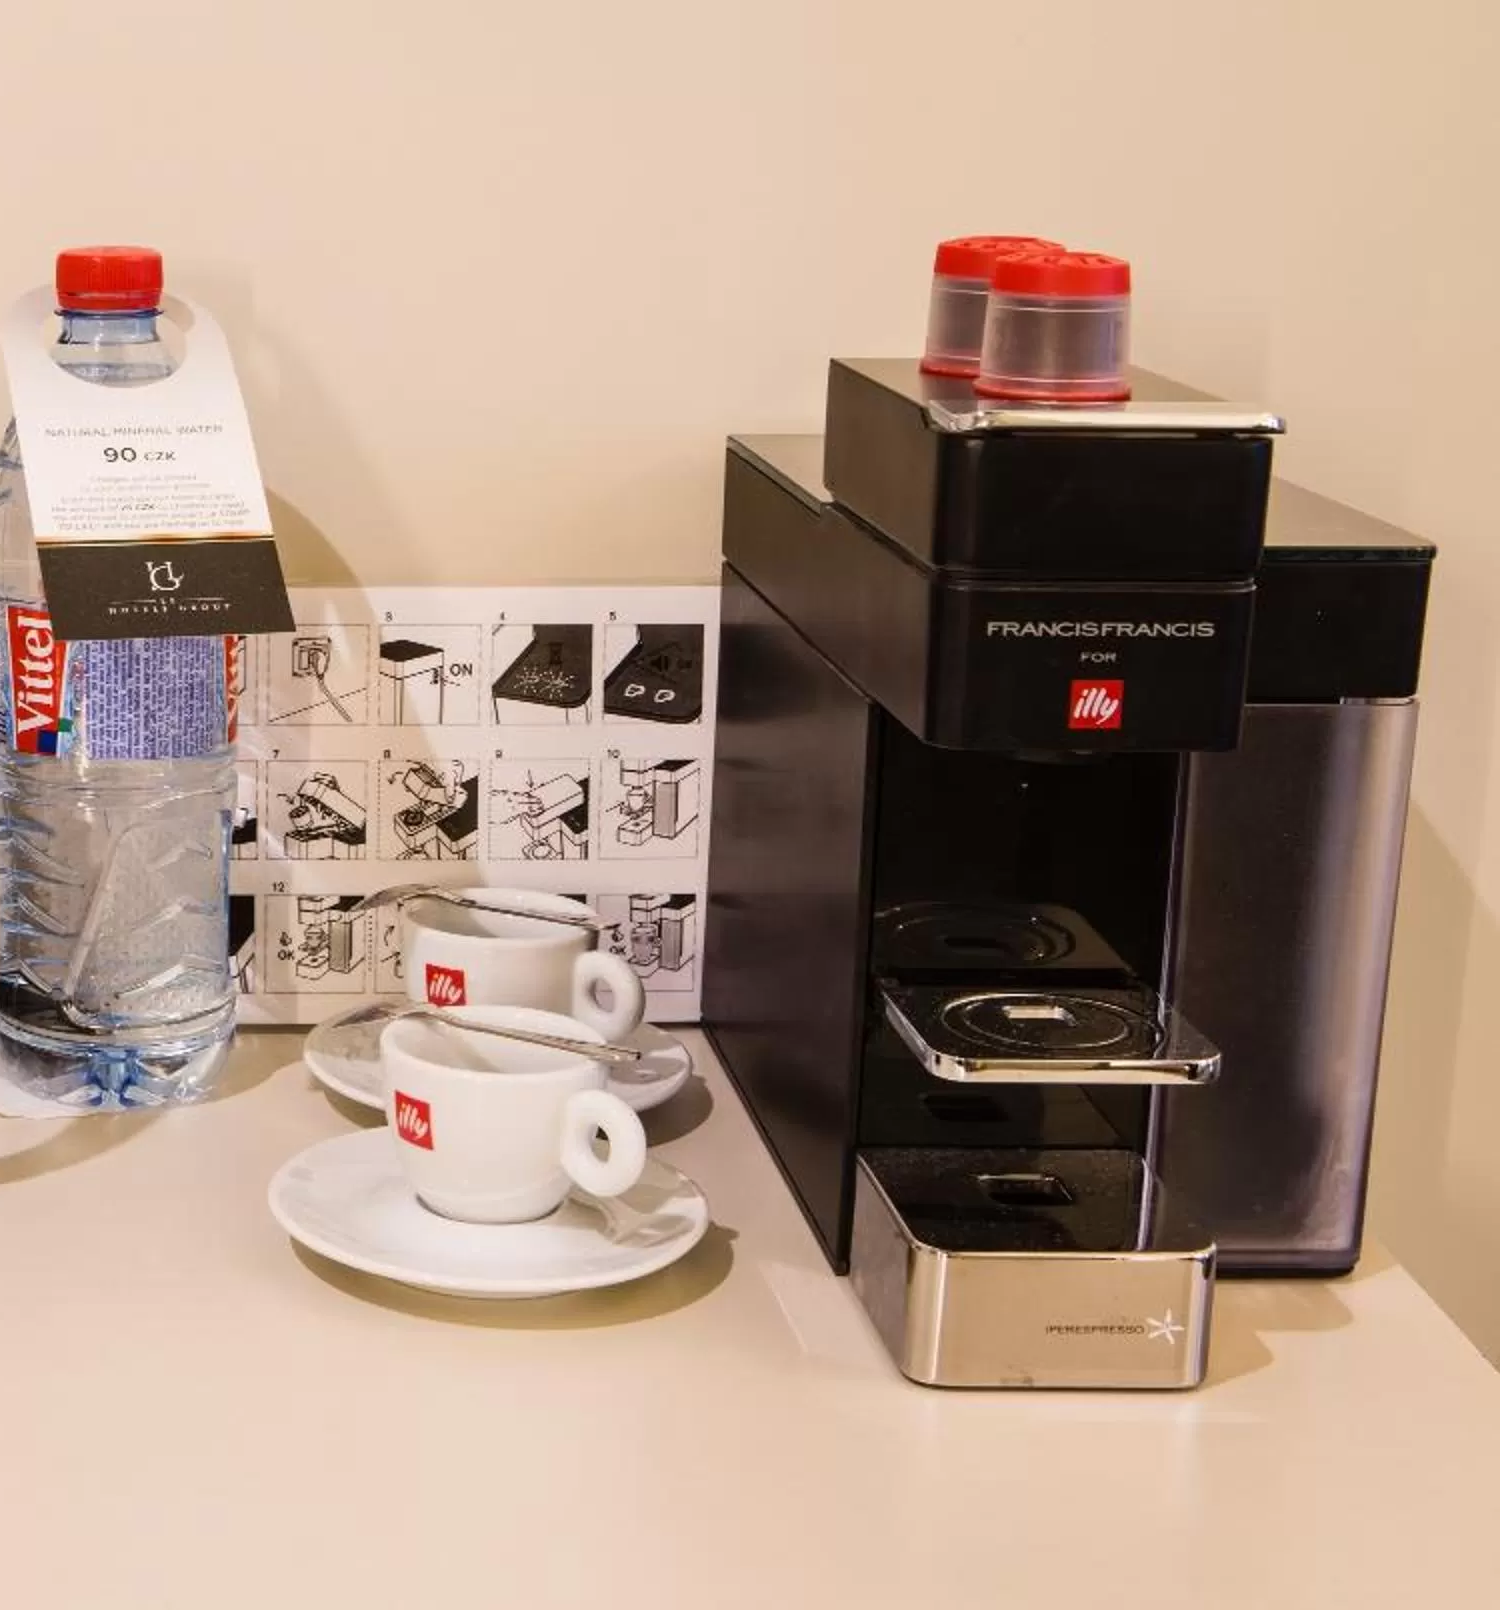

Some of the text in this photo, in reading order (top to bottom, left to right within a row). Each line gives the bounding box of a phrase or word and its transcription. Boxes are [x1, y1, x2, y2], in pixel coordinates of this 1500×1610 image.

[176, 424, 223, 435] WATER
[103, 447, 177, 463] 90 CZK
[609, 611, 617, 622] 5
[1080, 652, 1117, 663] FOR
[16, 615, 55, 734] Vittel
[449, 663, 474, 678] ON
[1073, 686, 1119, 725] illy
[272, 749, 280, 760] 7
[607, 749, 620, 760] 10
[272, 882, 286, 893] 12
[277, 948, 295, 961] OK
[609, 945, 626, 956] OK
[428, 972, 462, 1005] illy
[399, 1102, 430, 1140] illy
[1045, 1324, 1145, 1335] IPERESPRESSO
